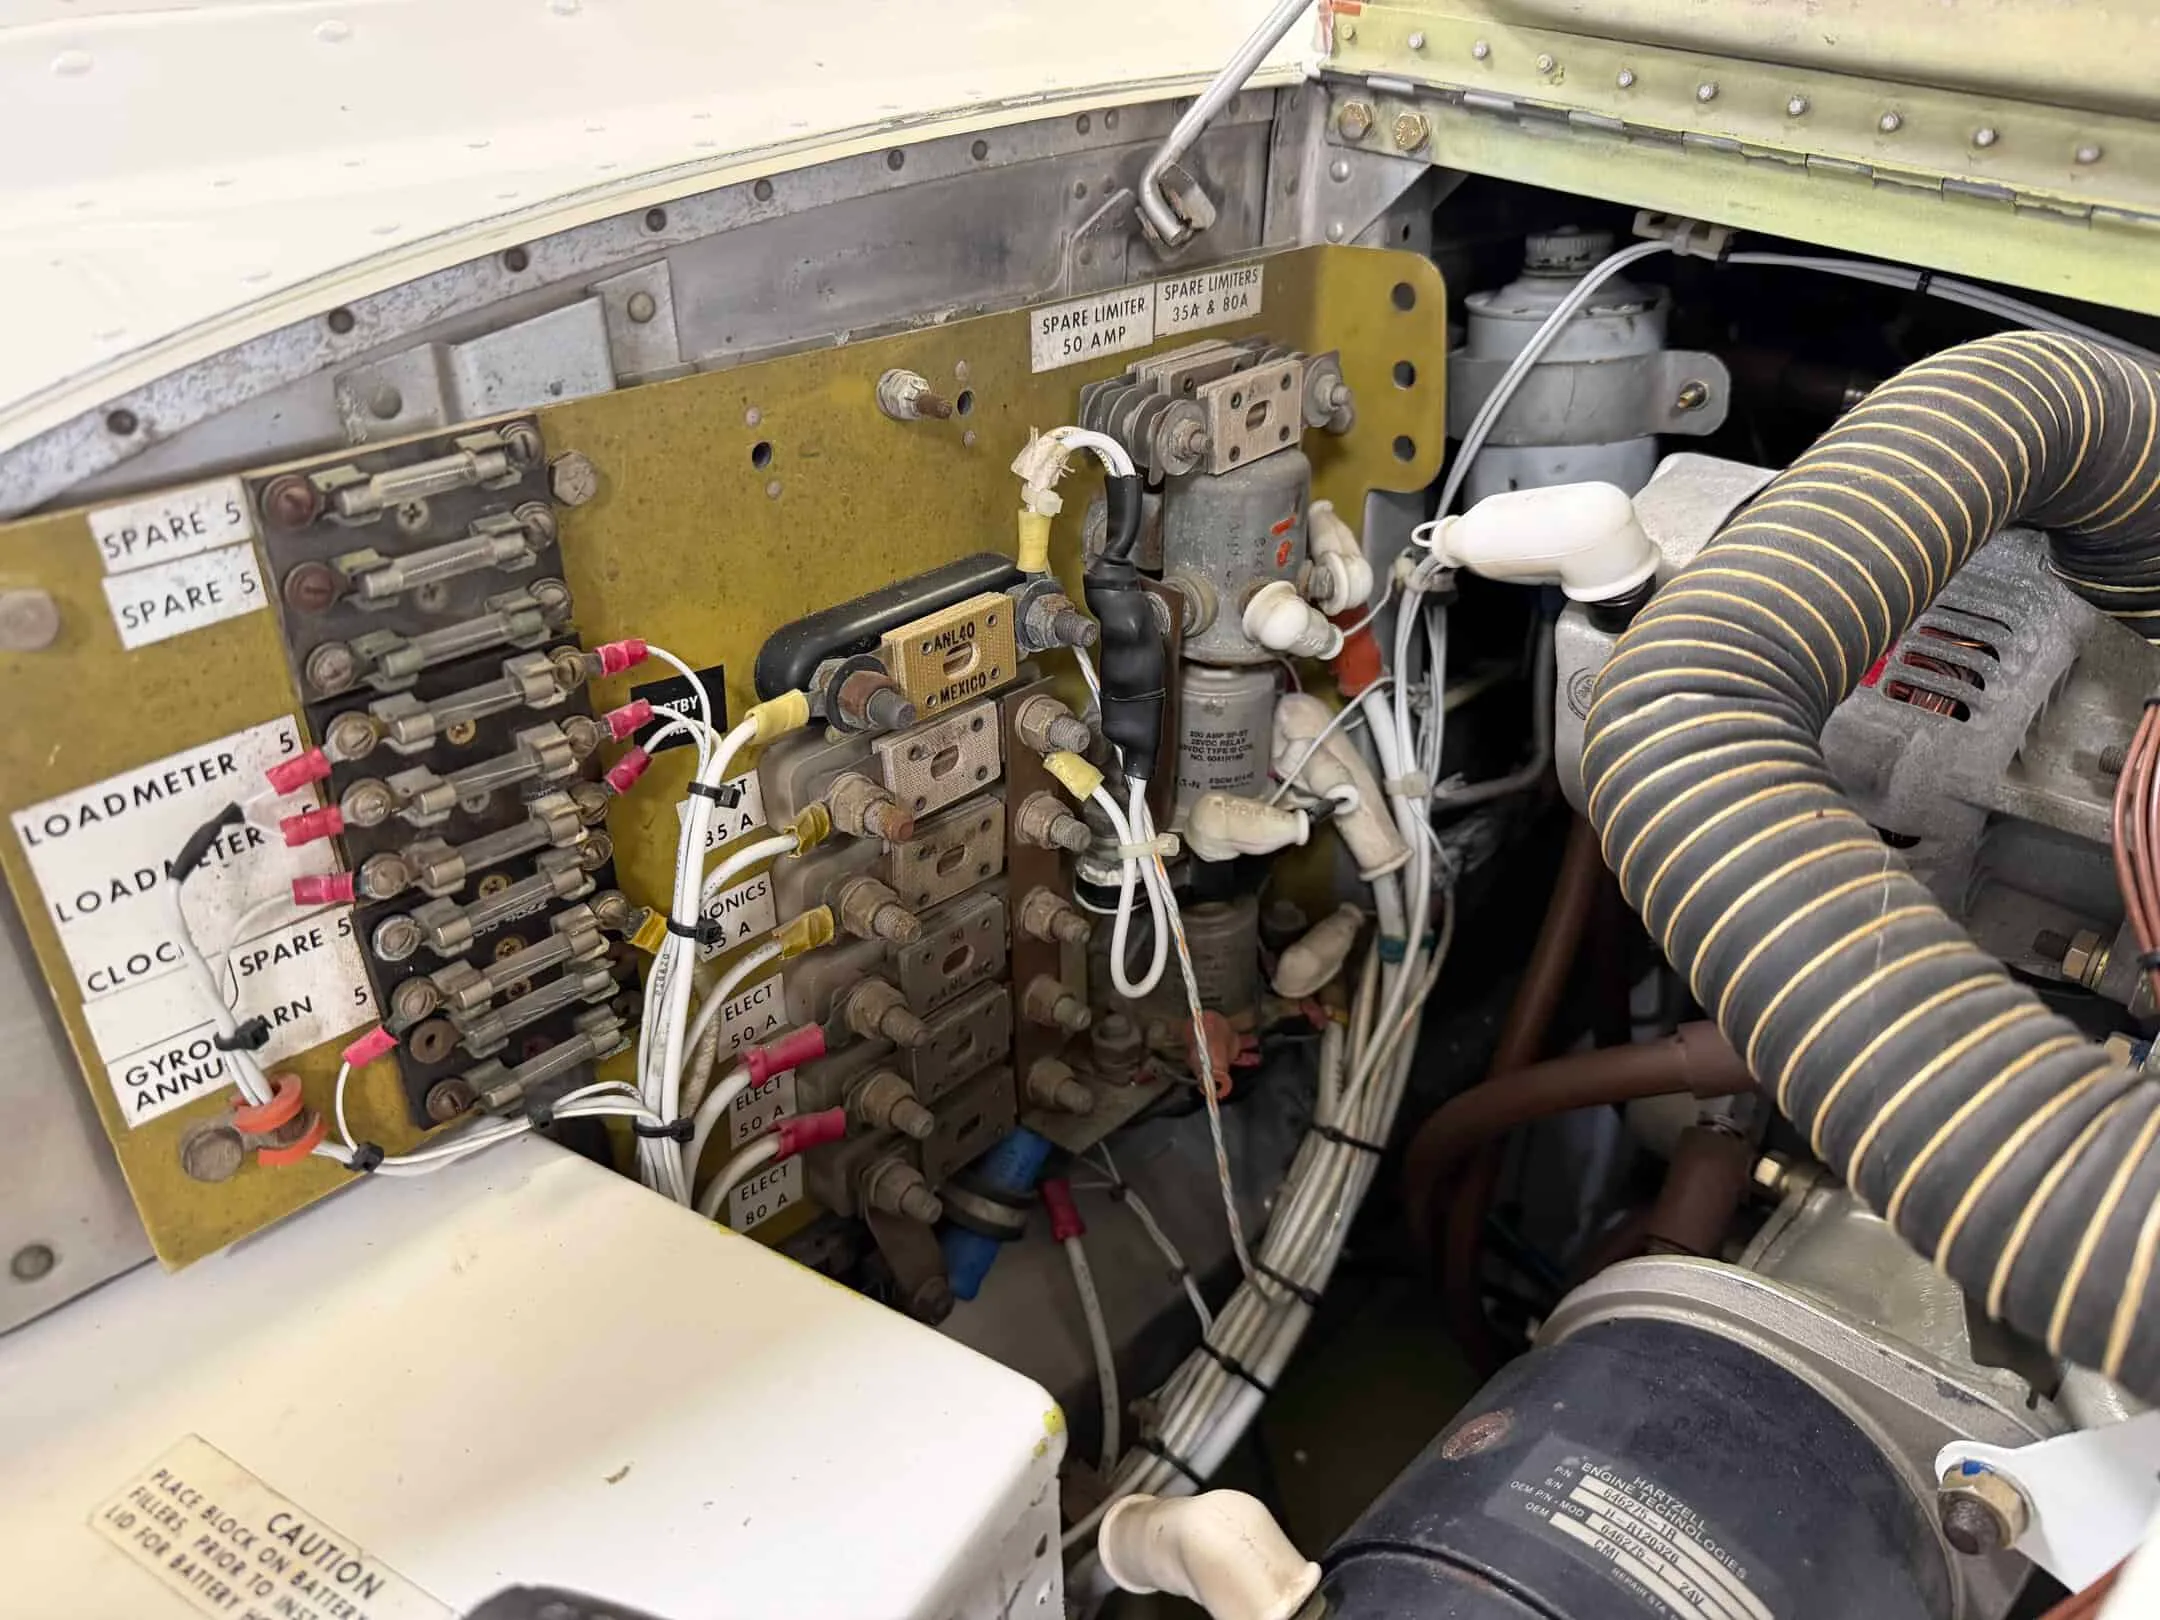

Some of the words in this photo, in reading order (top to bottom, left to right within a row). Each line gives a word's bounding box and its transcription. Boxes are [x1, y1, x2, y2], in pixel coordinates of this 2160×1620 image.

[1164, 278, 1204, 301] SPARE
[1208, 268, 1258, 294] LIMITERS
[1043, 309, 1088, 335] SPARE
[1094, 297, 1146, 324] LIMITER
[1172, 303, 1199, 323] 35A
[1206, 300, 1216, 315] &
[1223, 292, 1249, 313] 80A
[1063, 337, 1082, 356] 50
[1091, 325, 1127, 348] AMP
[103, 511, 207, 560] SPARE
[226, 501, 242, 526] 5
[122, 579, 224, 631] SPARE
[240, 571, 256, 597] 5
[933, 621, 976, 650] ANL40
[940, 671, 987, 705] MEXICO
[23, 752, 238, 847] LOADMETER
[280, 731, 295, 755] 5
[705, 823, 727, 847] 35
[741, 812, 753, 831] A
[56, 826, 266, 924] LOADTER
[702, 881, 767, 920] IONICS
[239, 928, 324, 977] SPARE
[338, 917, 351, 937] 5
[739, 921, 752, 938] A
[88, 941, 185, 994] CLOC
[725, 984, 772, 1022] ELECT
[126, 1039, 213, 1087] GYRO
[354, 986, 368, 1006] 5
[731, 1026, 755, 1049] 50
[766, 1014, 778, 1031] A
[137, 1056, 228, 1112] ANNU
[736, 1074, 783, 1112] ELECT
[739, 1116, 762, 1138] 50
[773, 1104, 785, 1121] A
[742, 1163, 789, 1201] ELECT
[746, 1203, 768, 1226] 80
[777, 1192, 788, 1208] A
[150, 1467, 205, 1510] PLACE
[199, 1504, 259, 1551] BLOCK
[257, 1546, 292, 1575] ON
[1525, 1501, 1550, 1517] OEM
[1559, 1500, 1585, 1517] MOD
[1581, 1462, 1637, 1495] ENGINE
[1637, 1491, 1748, 1580] TECHNOLOGIES
[1633, 1475, 1706, 1532] HARTZELL
[104, 1503, 137, 1531] LID
[133, 1525, 172, 1558] FOR
[168, 1552, 242, 1611] BATTERY
[192, 1533, 248, 1577] PRIOR
[246, 1572, 275, 1597] TO
[267, 1512, 386, 1600] CAUTION
